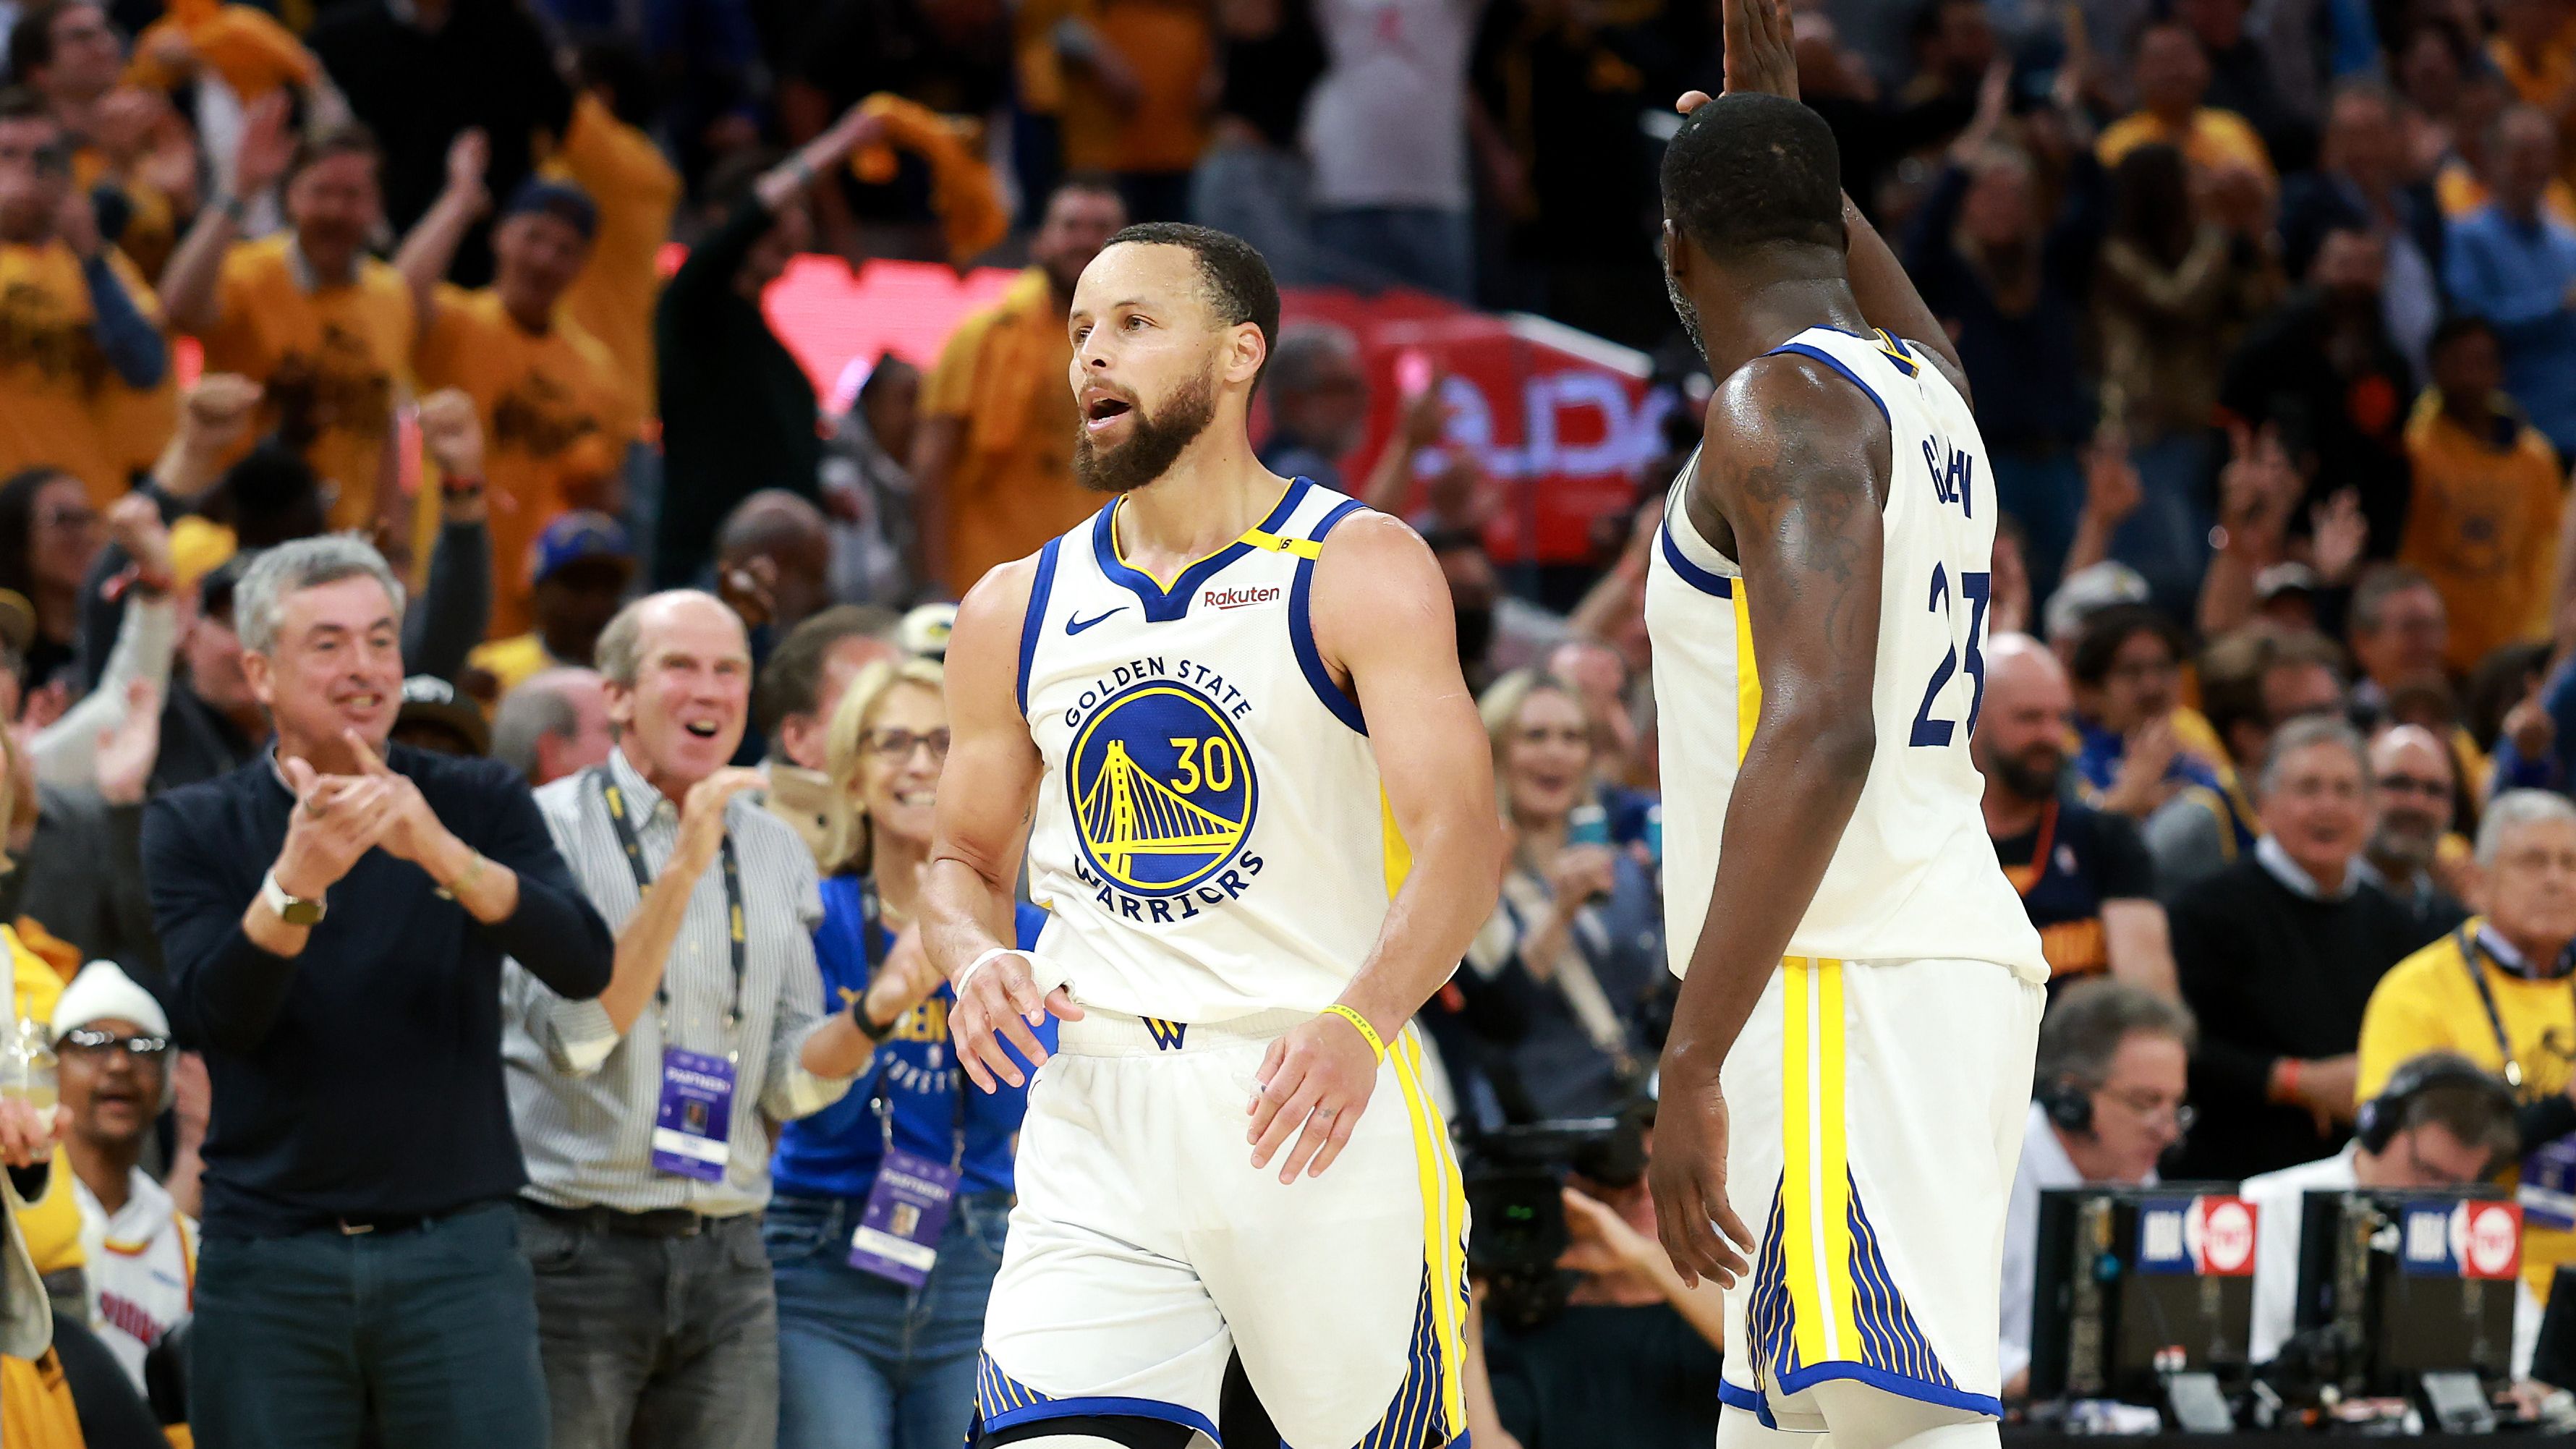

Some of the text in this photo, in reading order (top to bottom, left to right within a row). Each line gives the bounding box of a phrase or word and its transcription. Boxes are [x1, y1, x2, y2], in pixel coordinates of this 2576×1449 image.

[1922, 434, 1973, 519] GEN
[1204, 587, 1280, 608] Rakuten
[1908, 560, 1991, 747] 23
[1066, 656, 1252, 728] GOLDEN STATE
[1169, 736, 1233, 794] 30
[1074, 850, 1264, 924] WARRIORS
